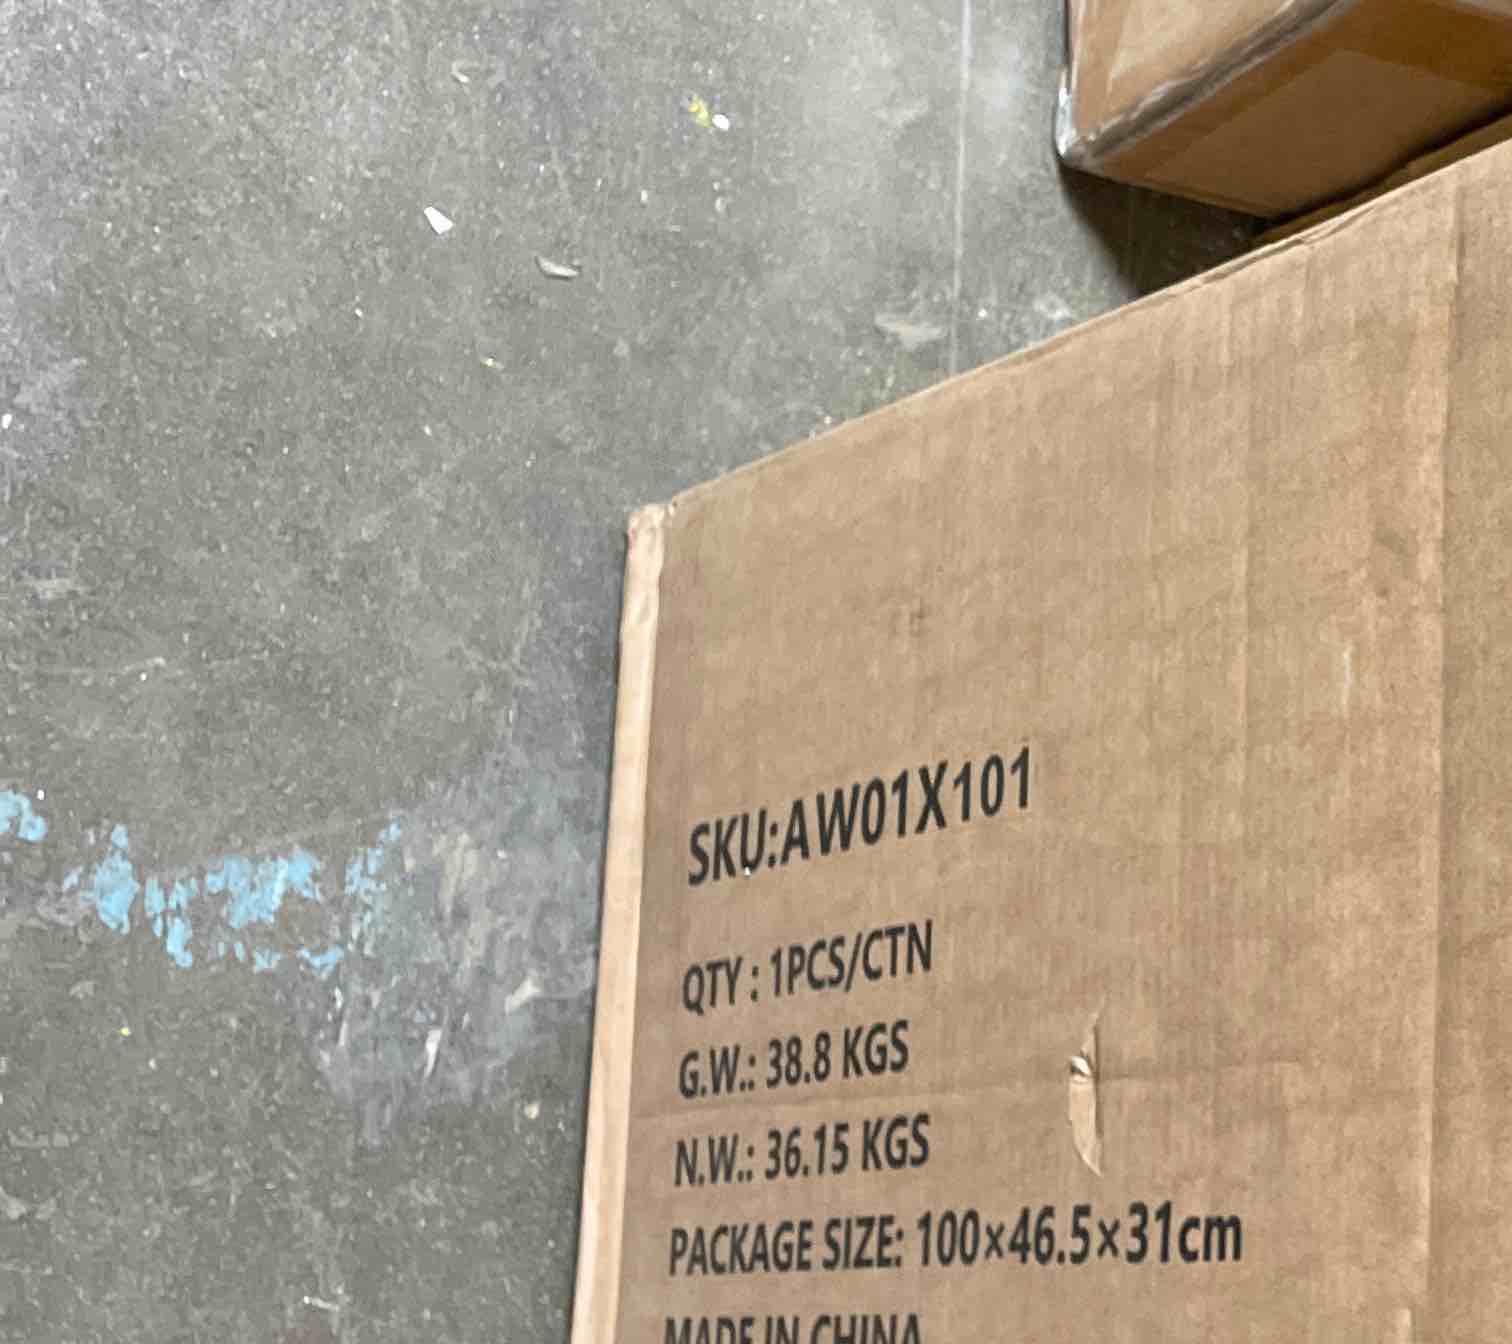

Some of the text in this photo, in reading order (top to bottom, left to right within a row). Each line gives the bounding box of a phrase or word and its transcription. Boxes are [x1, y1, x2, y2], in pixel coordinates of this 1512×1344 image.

[687, 746, 1032, 886] SKU:AW01X101
[682, 957, 742, 1015] QTY
[769, 919, 934, 997] 1PCS/CTN
[678, 1019, 910, 1098] G.W.: 38.8 KGS
[674, 1112, 931, 1187] N.W.: 36.15 KGS
[668, 1219, 812, 1277] PACKAGE
[822, 1215, 905, 1270] SIZE:
